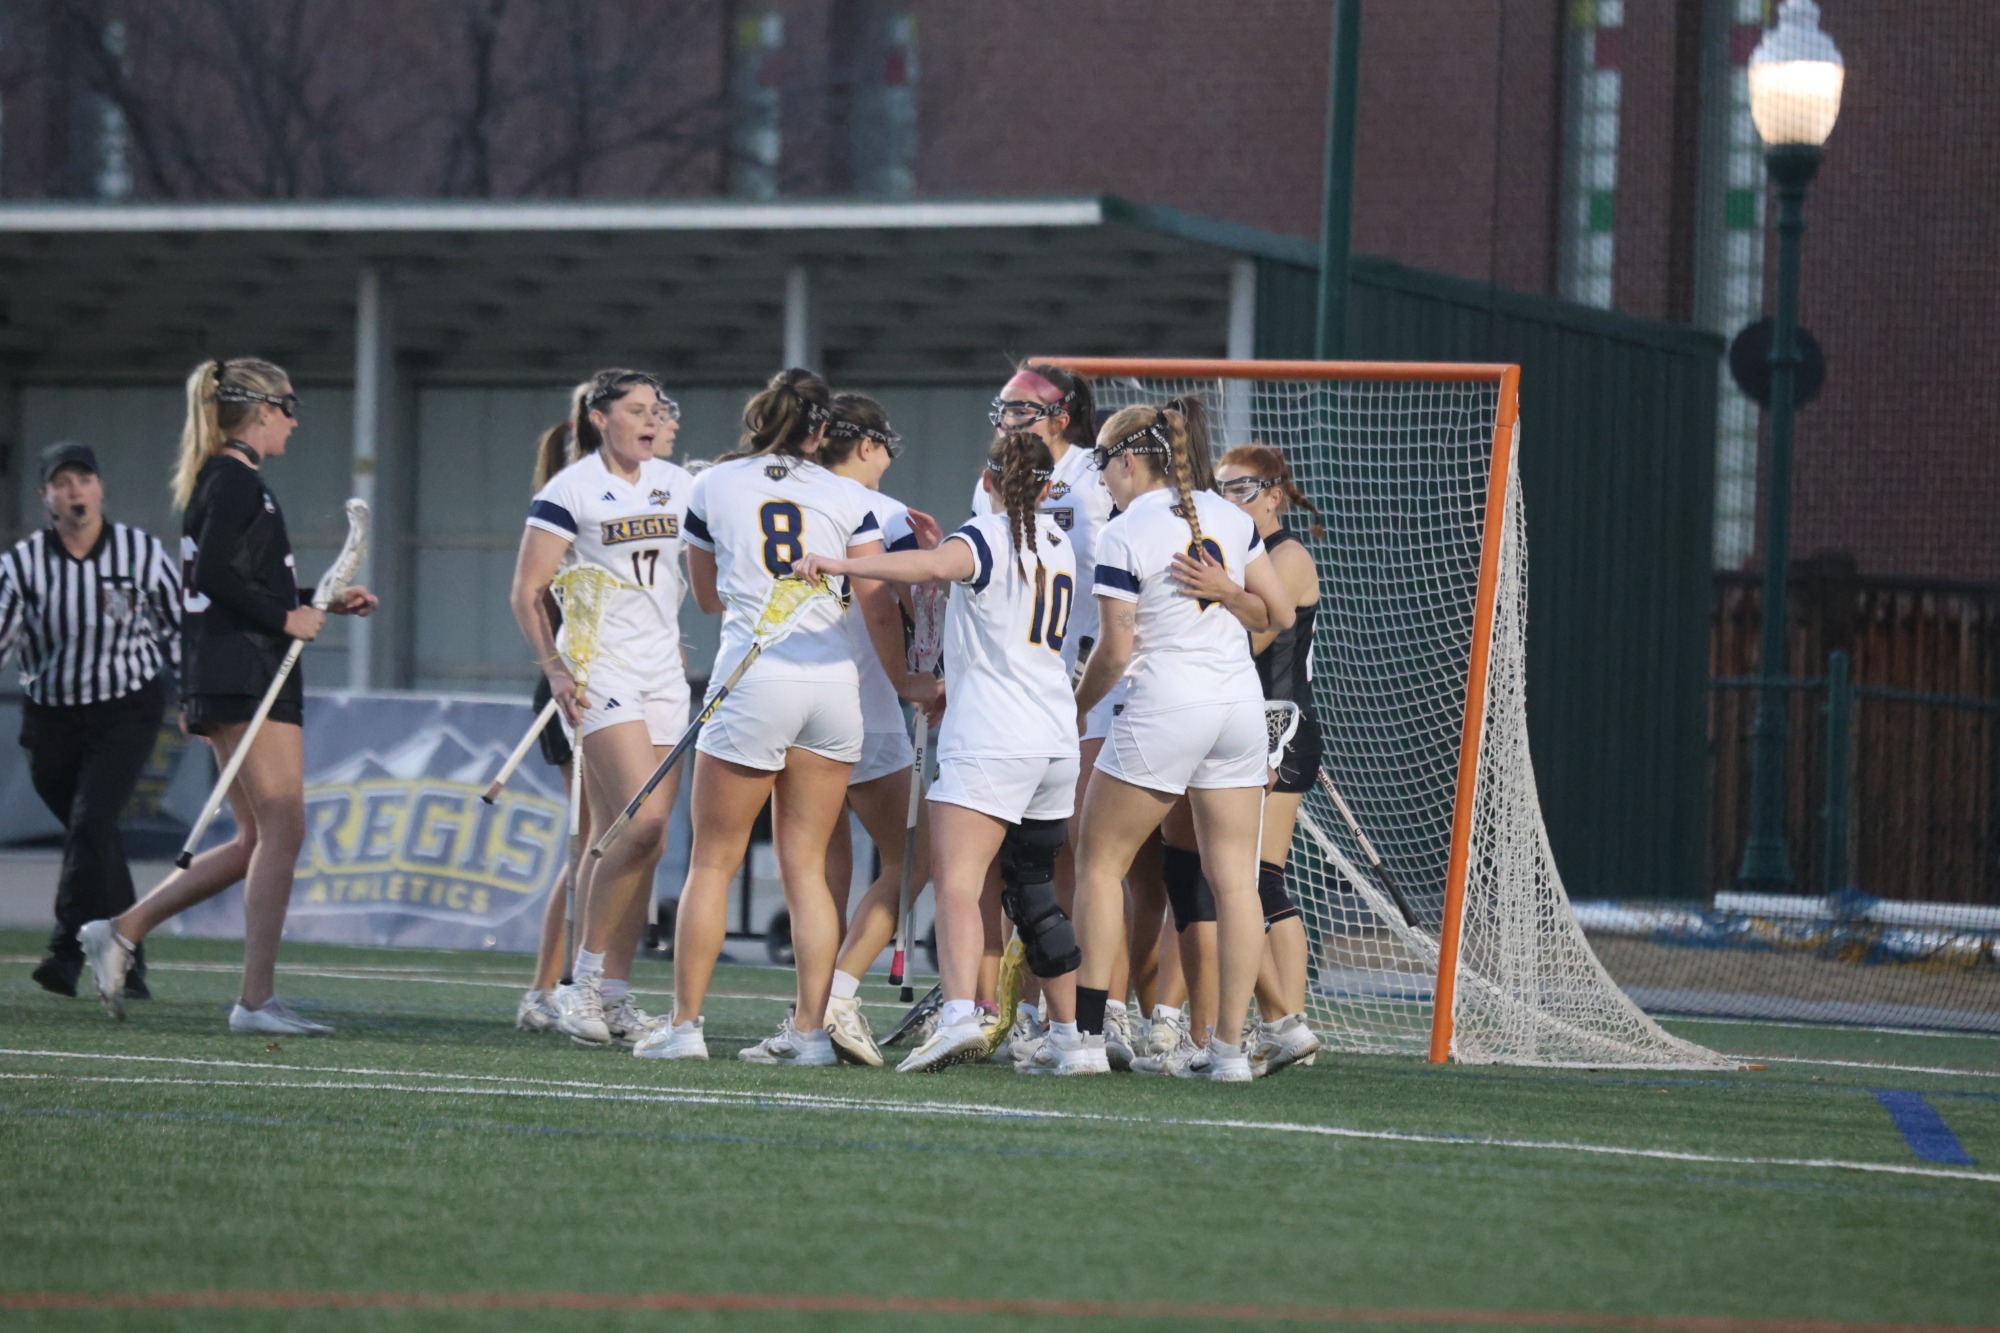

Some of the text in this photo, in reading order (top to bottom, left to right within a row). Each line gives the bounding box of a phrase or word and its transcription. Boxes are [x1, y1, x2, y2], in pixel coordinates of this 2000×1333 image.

[1107, 441, 1125, 456] GAIT
[1127, 429, 1147, 443] GAIT
[606, 517, 679, 541] REGIS
[757, 499, 805, 578] 8
[630, 549, 659, 587] 17
[1028, 565, 1073, 654] 10
[915, 747, 923, 774] GAIT
[301, 787, 555, 885] REGIS
[306, 875, 490, 914] ATHLETICS
